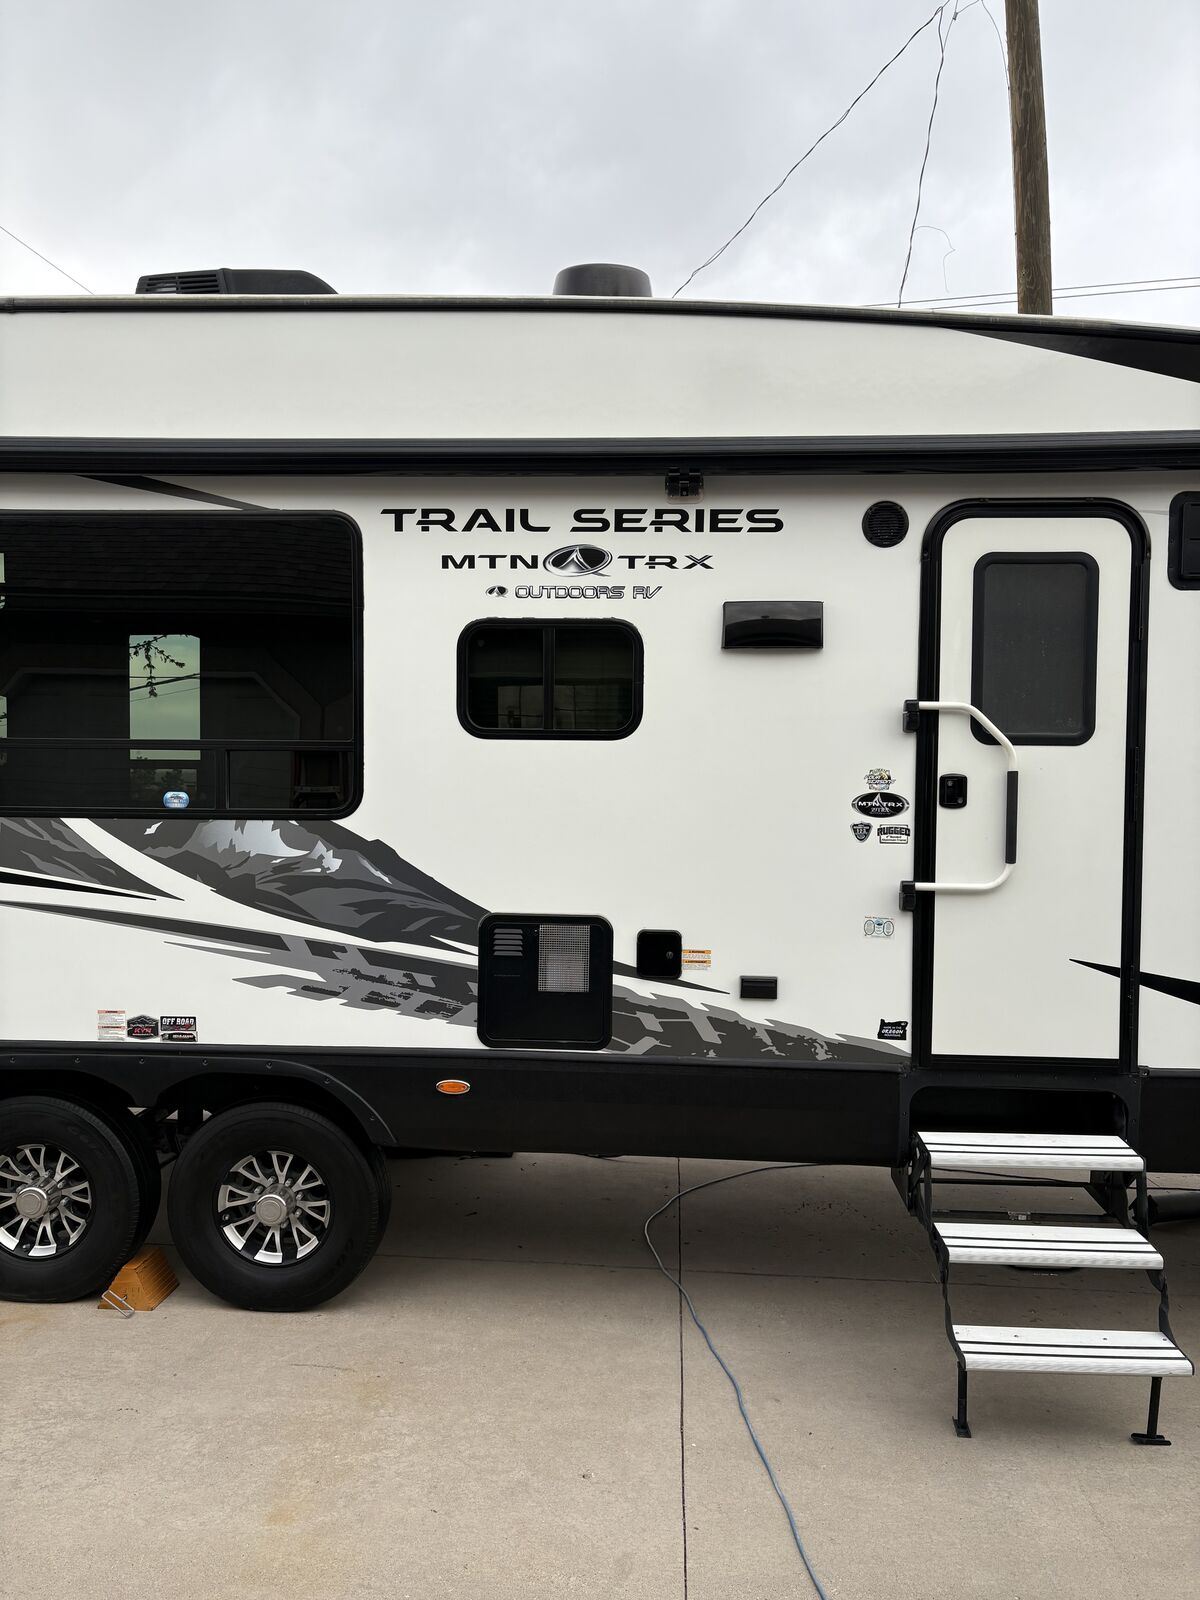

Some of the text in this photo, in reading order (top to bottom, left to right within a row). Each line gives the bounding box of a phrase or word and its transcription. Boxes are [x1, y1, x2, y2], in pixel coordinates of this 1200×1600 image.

[381, 508, 784, 533] TRAIL SERIES
[441, 554, 714, 570] MTN TRX
[515, 585, 663, 599] OUTDOORS RV
[877, 826, 911, 837] RUGGED
[162, 1017, 175, 1025] OFF
